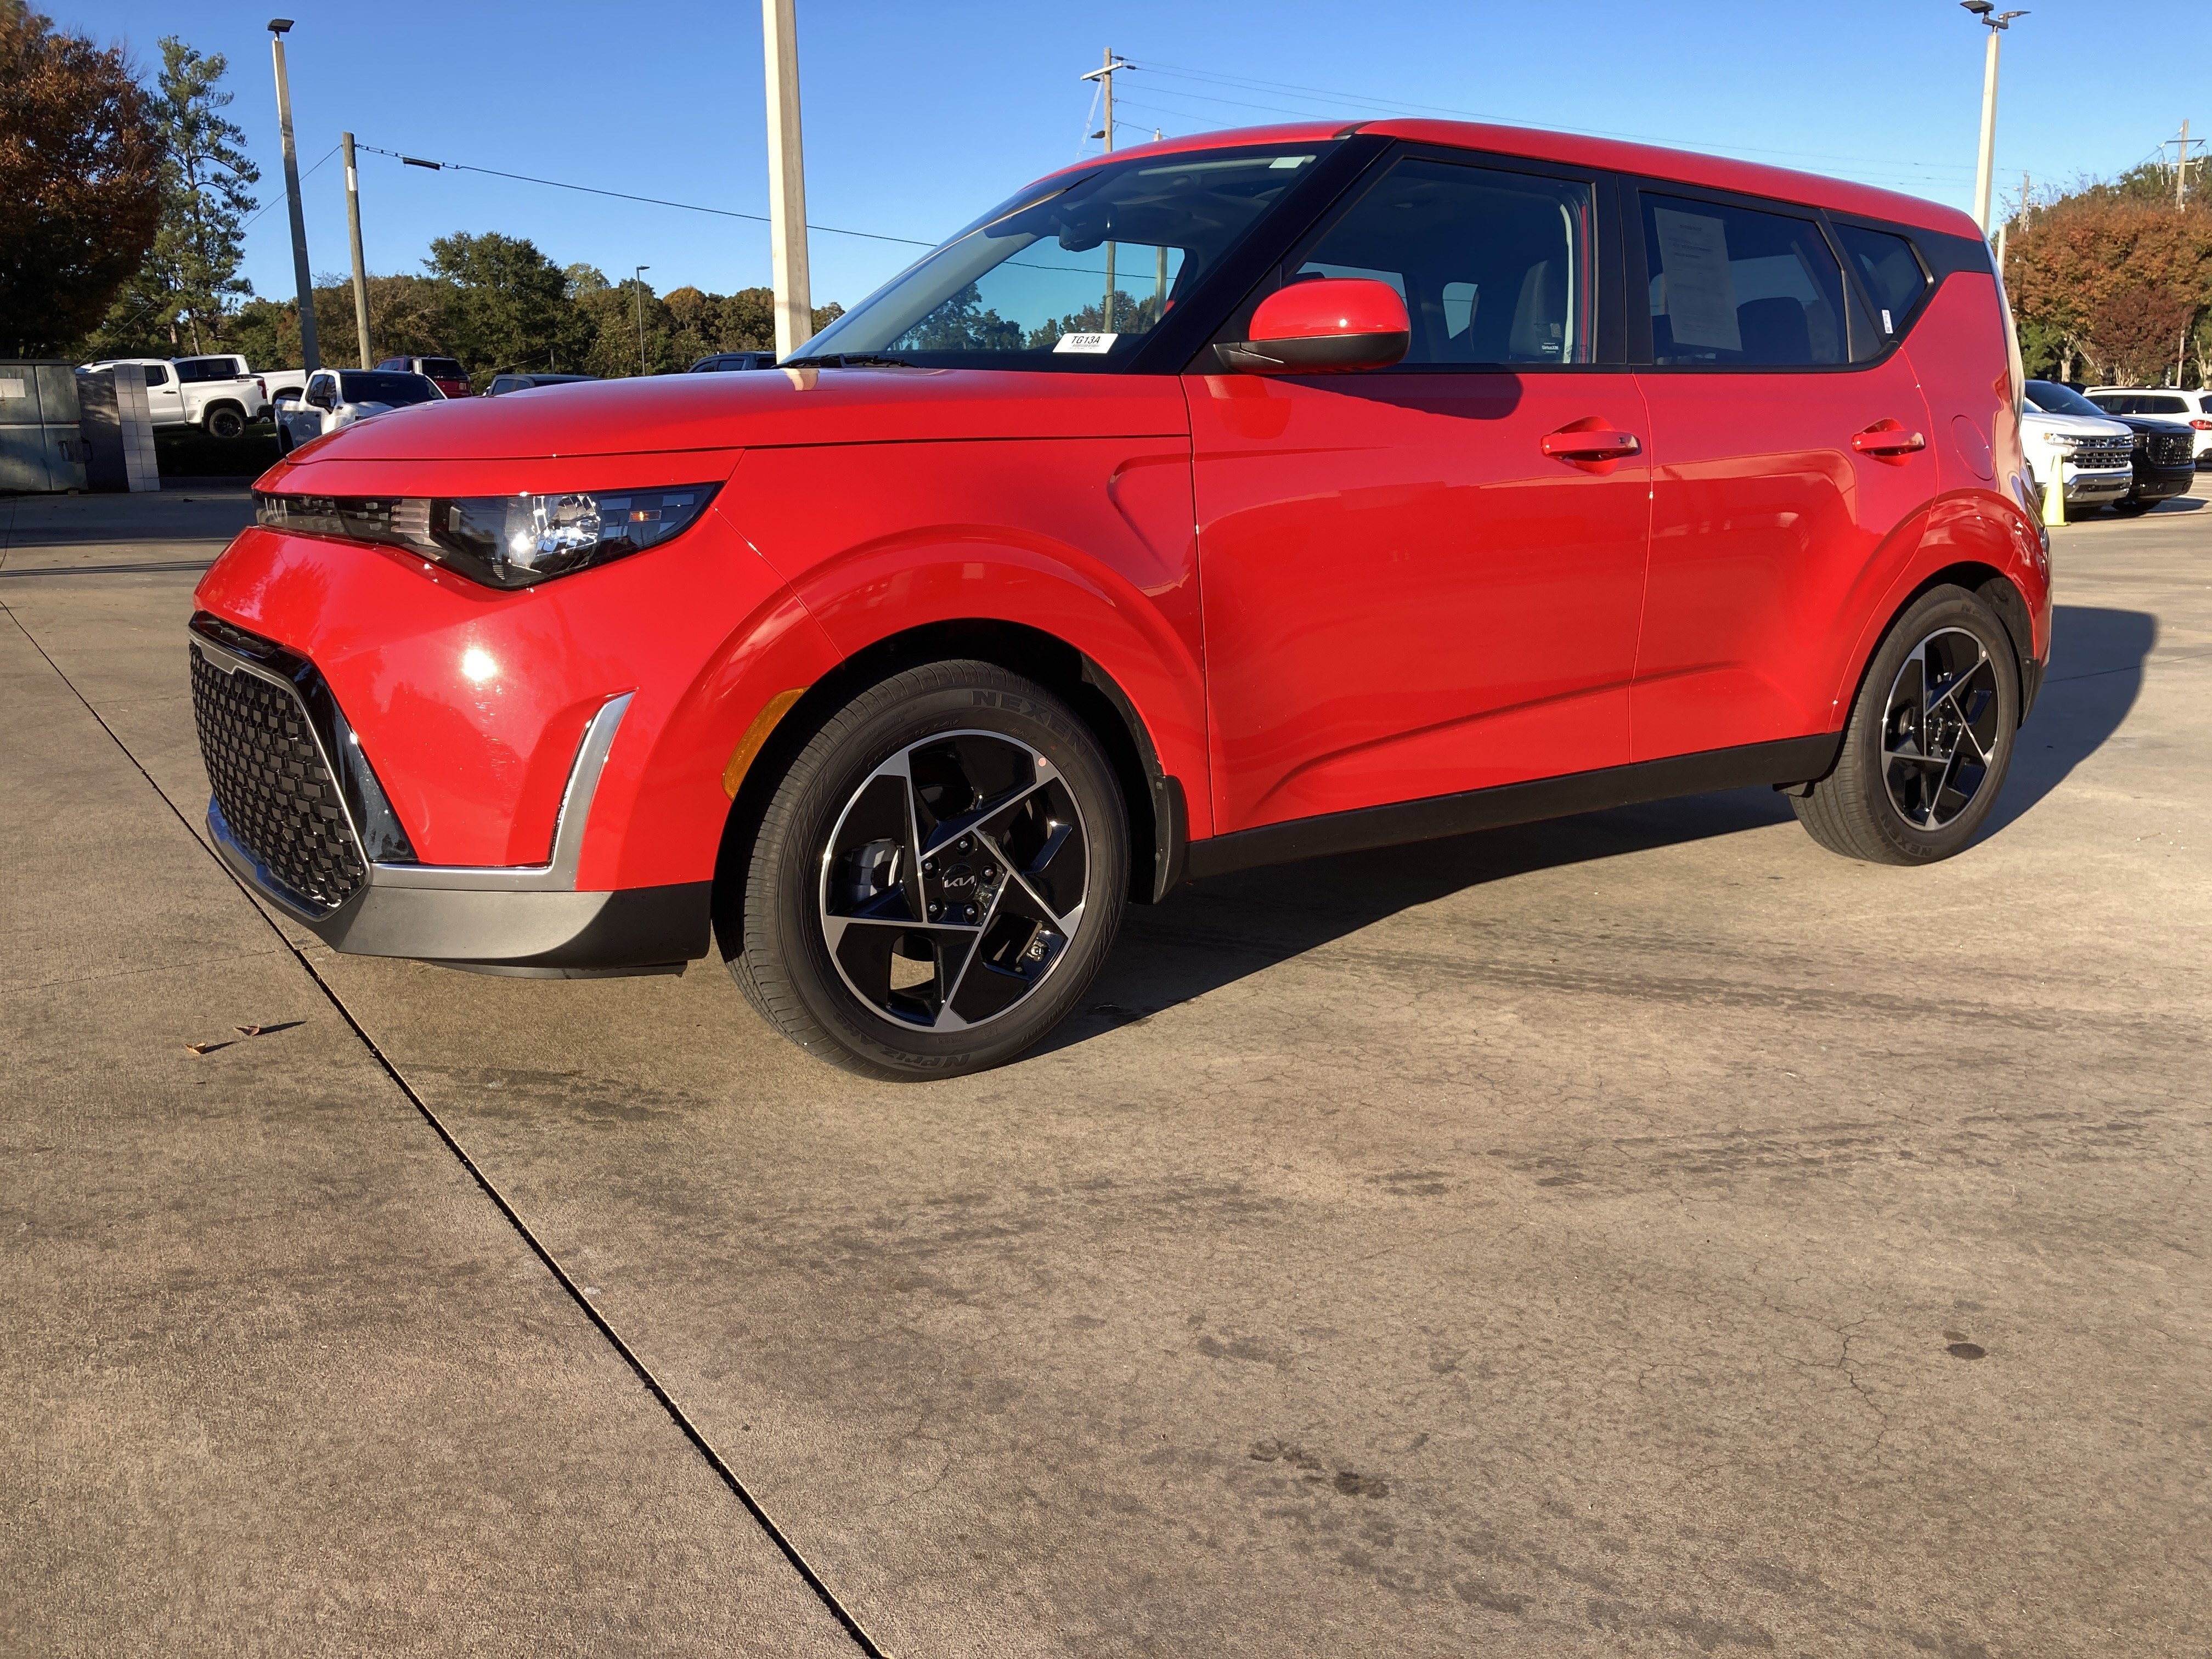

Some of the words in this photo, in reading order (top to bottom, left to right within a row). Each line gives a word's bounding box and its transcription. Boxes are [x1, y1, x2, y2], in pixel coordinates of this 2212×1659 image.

[1071, 336, 1101, 344] TG13A
[972, 690, 1088, 758] NEXEN
[944, 875, 975, 888] KIA
